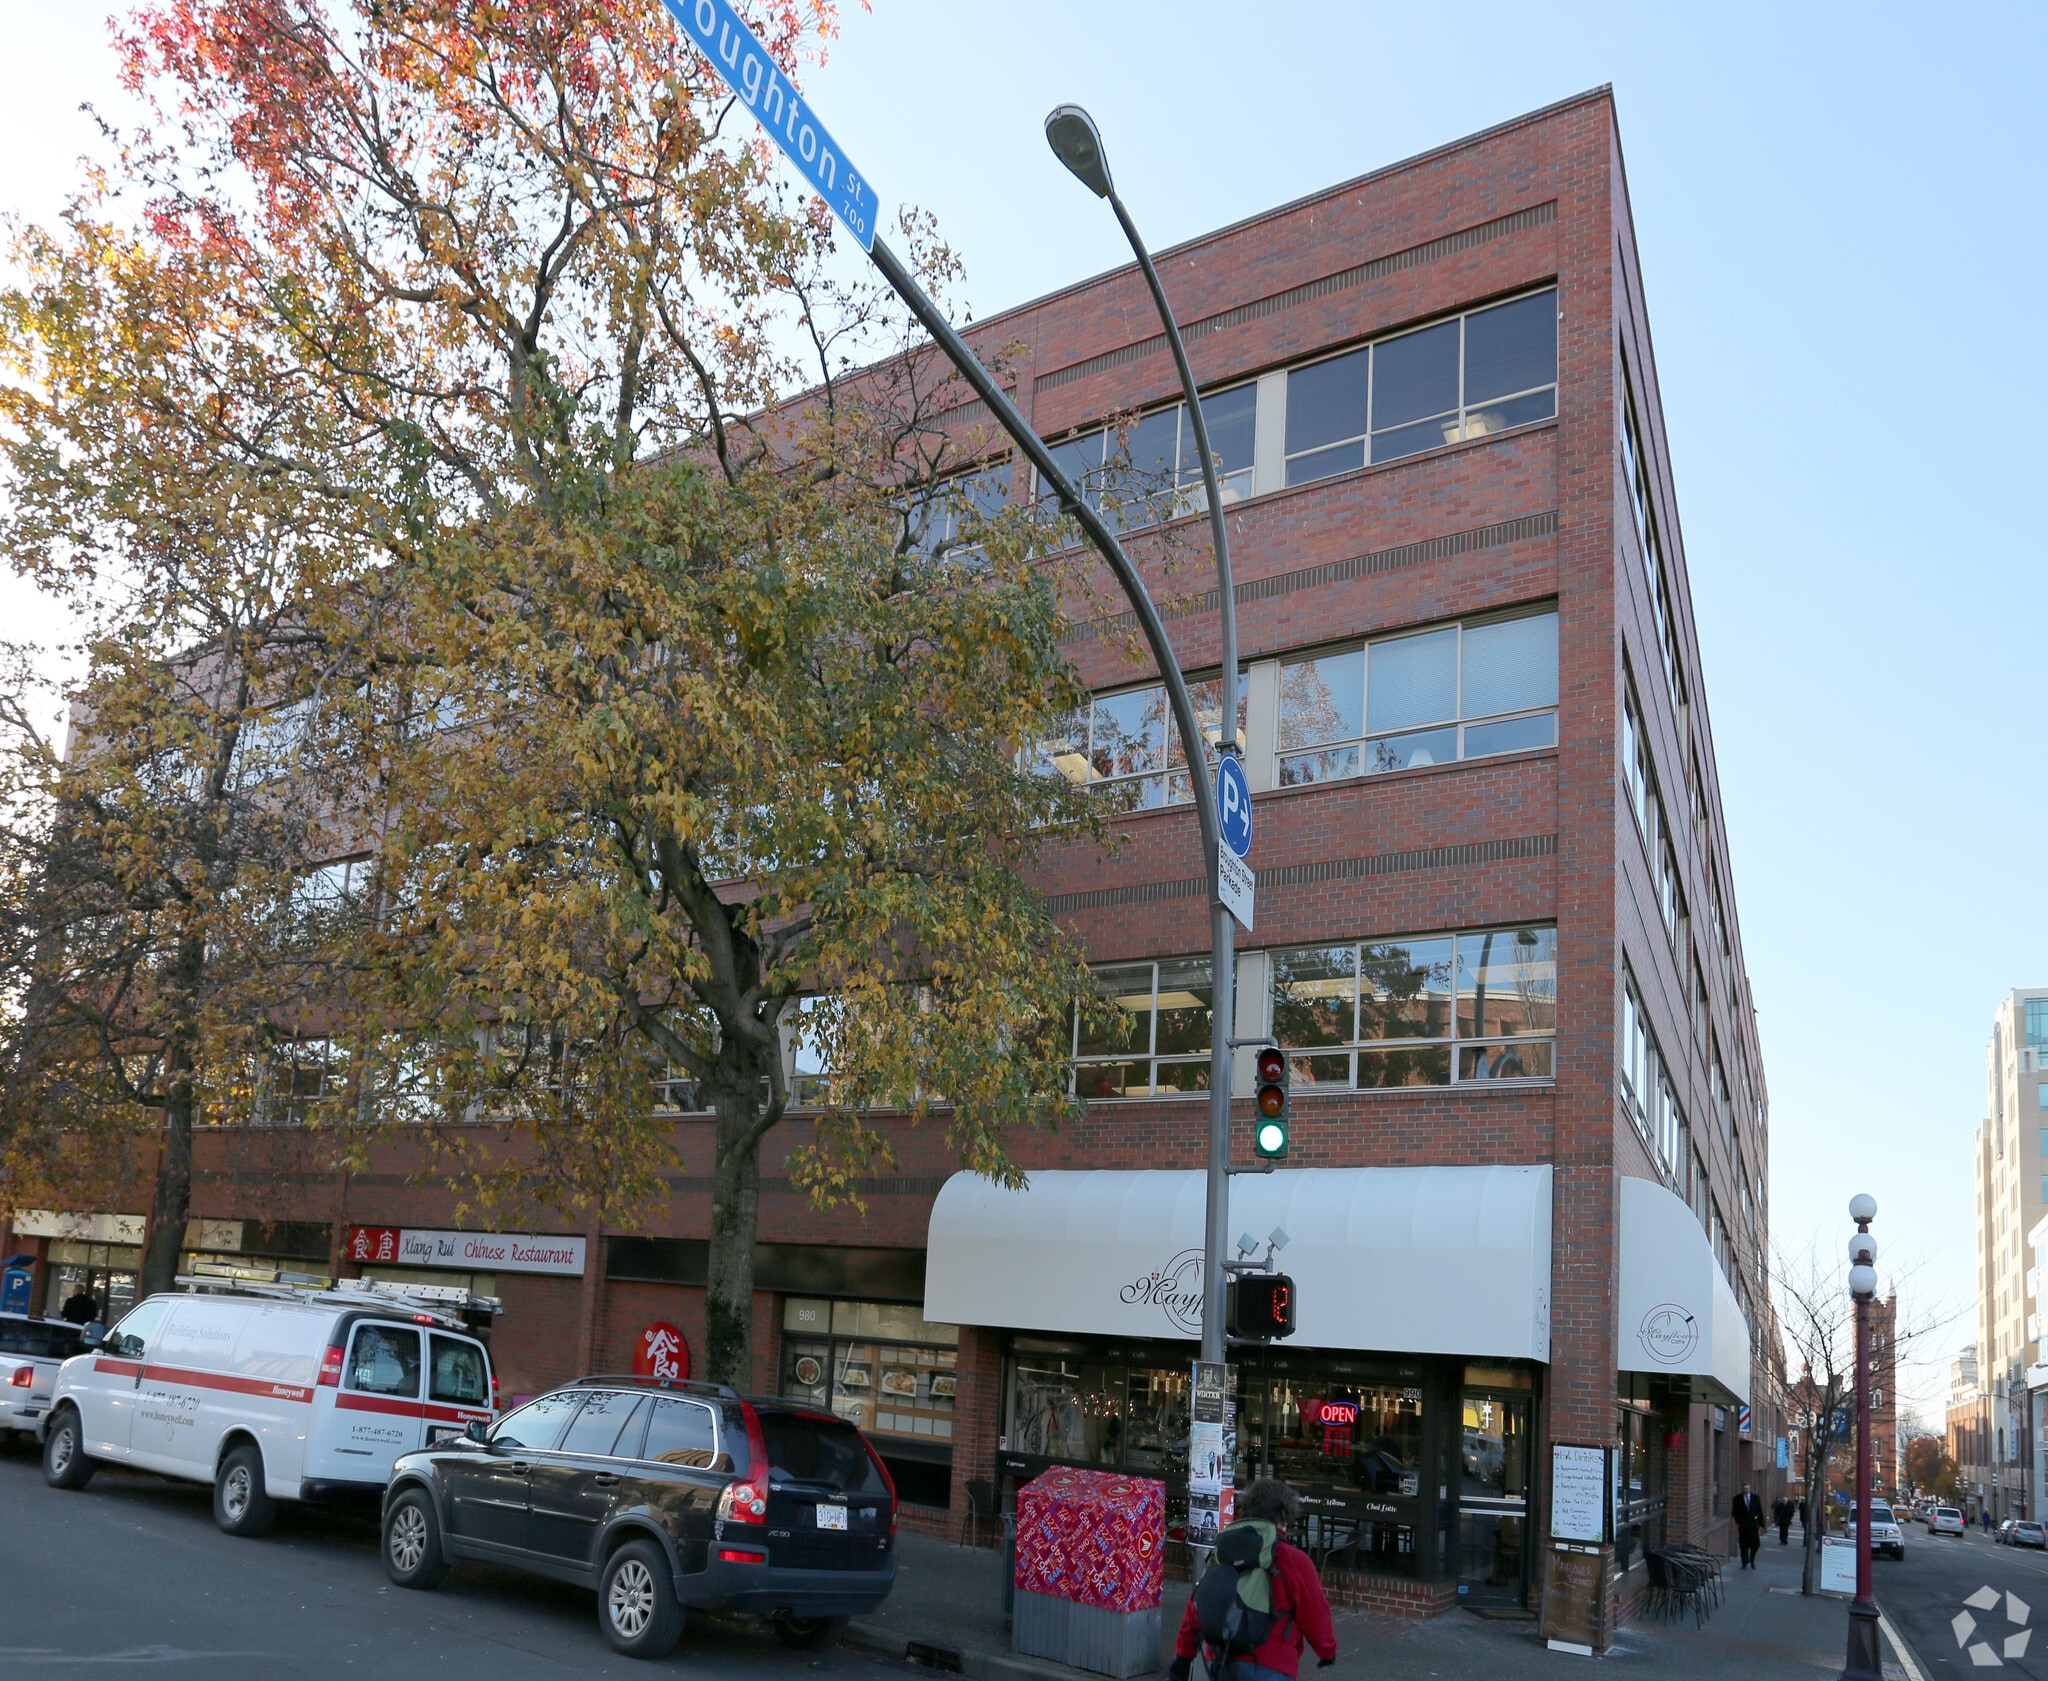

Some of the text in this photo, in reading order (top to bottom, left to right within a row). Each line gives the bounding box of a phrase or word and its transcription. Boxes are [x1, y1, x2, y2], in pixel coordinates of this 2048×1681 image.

[677, 0, 865, 207] oughton St.
[844, 199, 865, 234] 700
[1223, 769, 1239, 825] P
[1220, 845, 1254, 893] Broughton Street
[1219, 864, 1241, 898] Parkade
[401, 1236, 575, 1265] Xiang Rui Chinese Restaurant
[12, 1278, 24, 1290] P
[798, 1309, 816, 1322] 980
[166, 1323, 232, 1342] Building Solutions
[272, 1384, 305, 1398] Honeywell
[1404, 1388, 1421, 1398] 990
[140, 1409, 195, 1426] www.honeywell.com
[457, 1411, 491, 1423] Honeywell
[1321, 1404, 1355, 1423] OPEN
[351, 1435, 402, 1444] www.honeywell.com
[352, 1425, 403, 1438] 1-877-487-6720
[1574, 1451, 1600, 1464] Drinks
[1044, 1512, 1060, 1534] B2Z
[1098, 1522, 1114, 1545] B2Z
[1033, 1553, 1051, 1580] T9K
[1087, 1565, 1105, 1592] T9K
